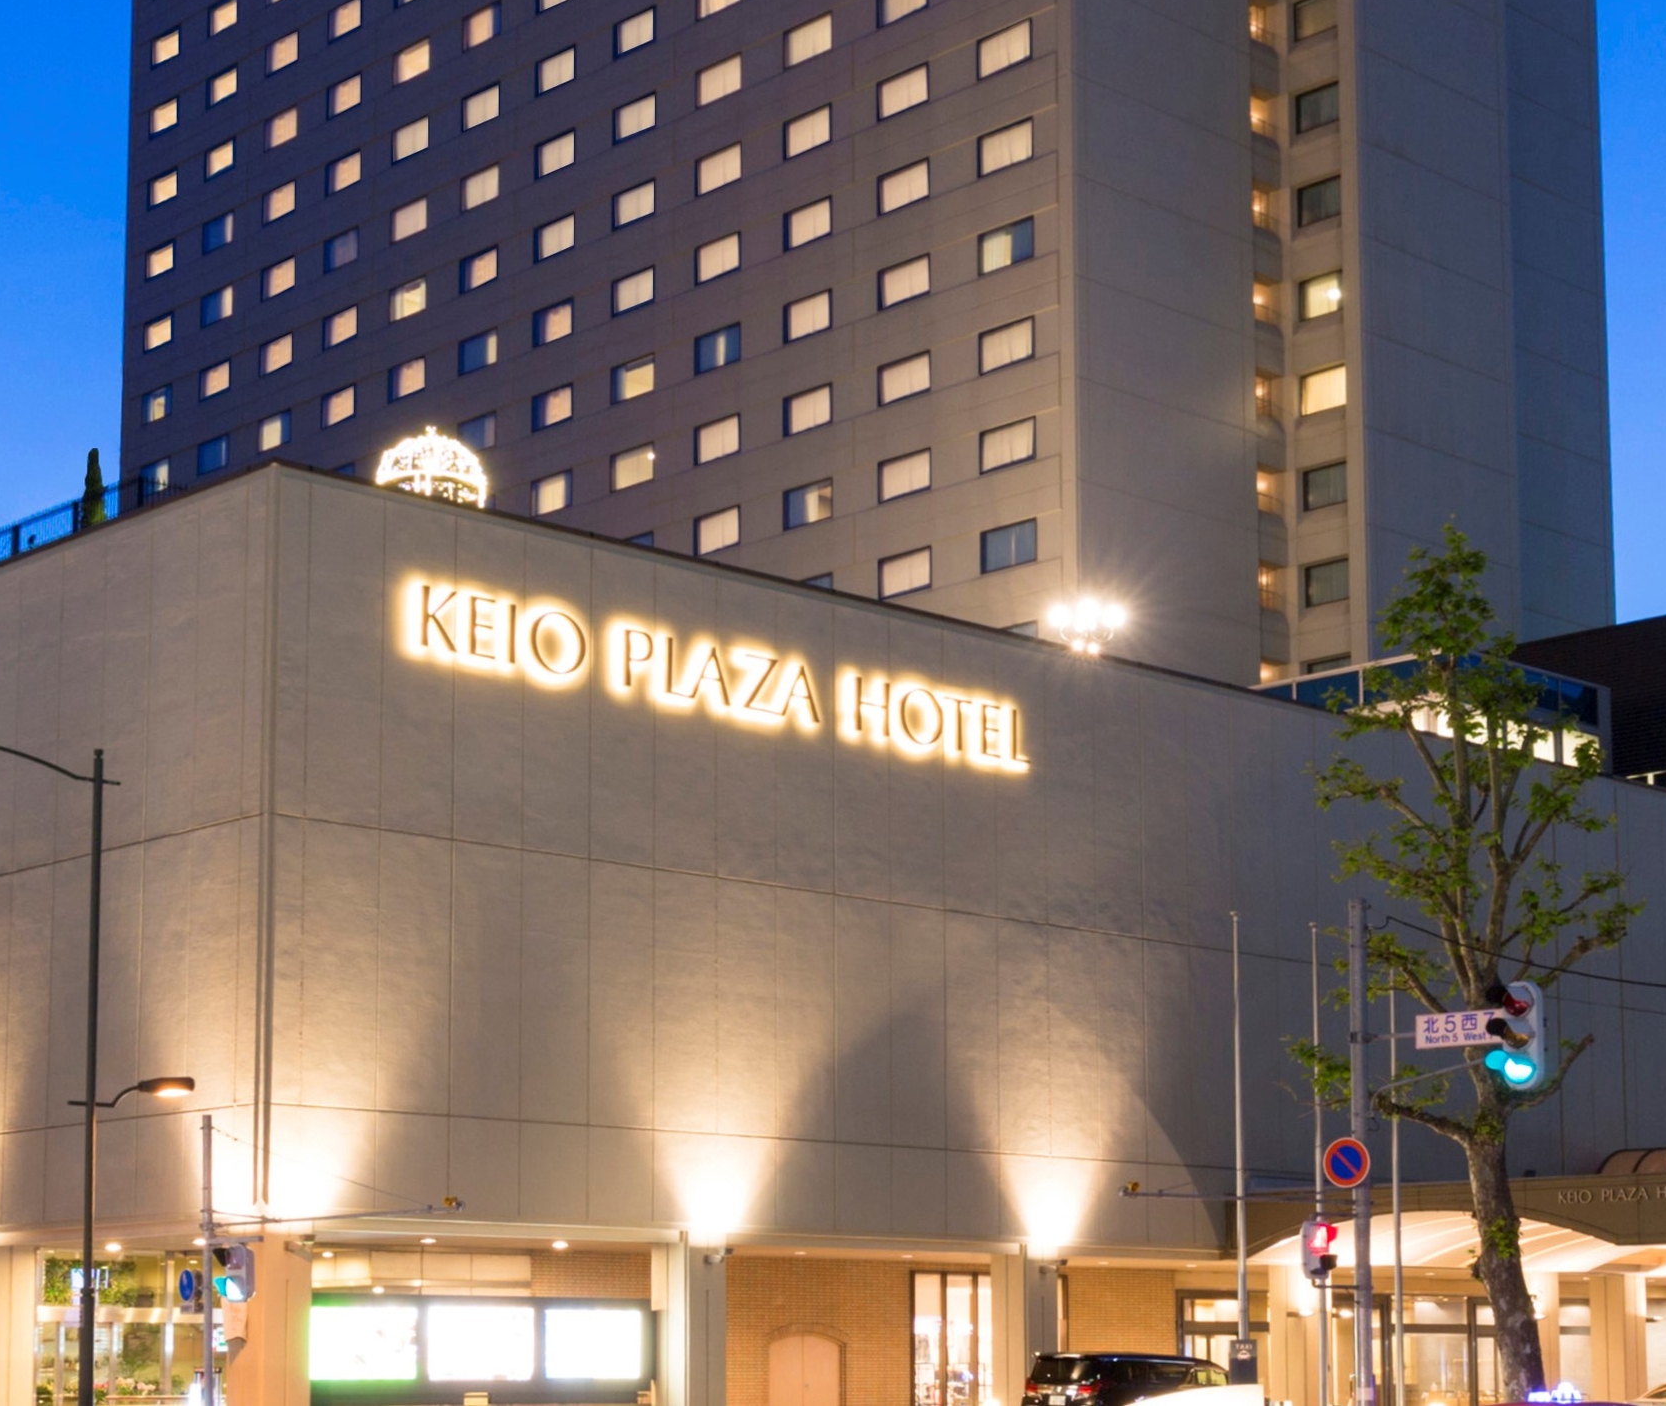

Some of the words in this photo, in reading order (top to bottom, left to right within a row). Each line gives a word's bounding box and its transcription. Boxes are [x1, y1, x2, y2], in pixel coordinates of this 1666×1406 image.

[419, 584, 588, 675] KEIO
[622, 628, 822, 724] PLAZA
[853, 675, 1032, 765] HOTEL
[1425, 1035, 1450, 1045] North
[1452, 1034, 1459, 1043] 5
[1463, 1031, 1487, 1041] West
[1558, 1189, 1593, 1205] KEIO
[1601, 1186, 1650, 1203] PLAZA
